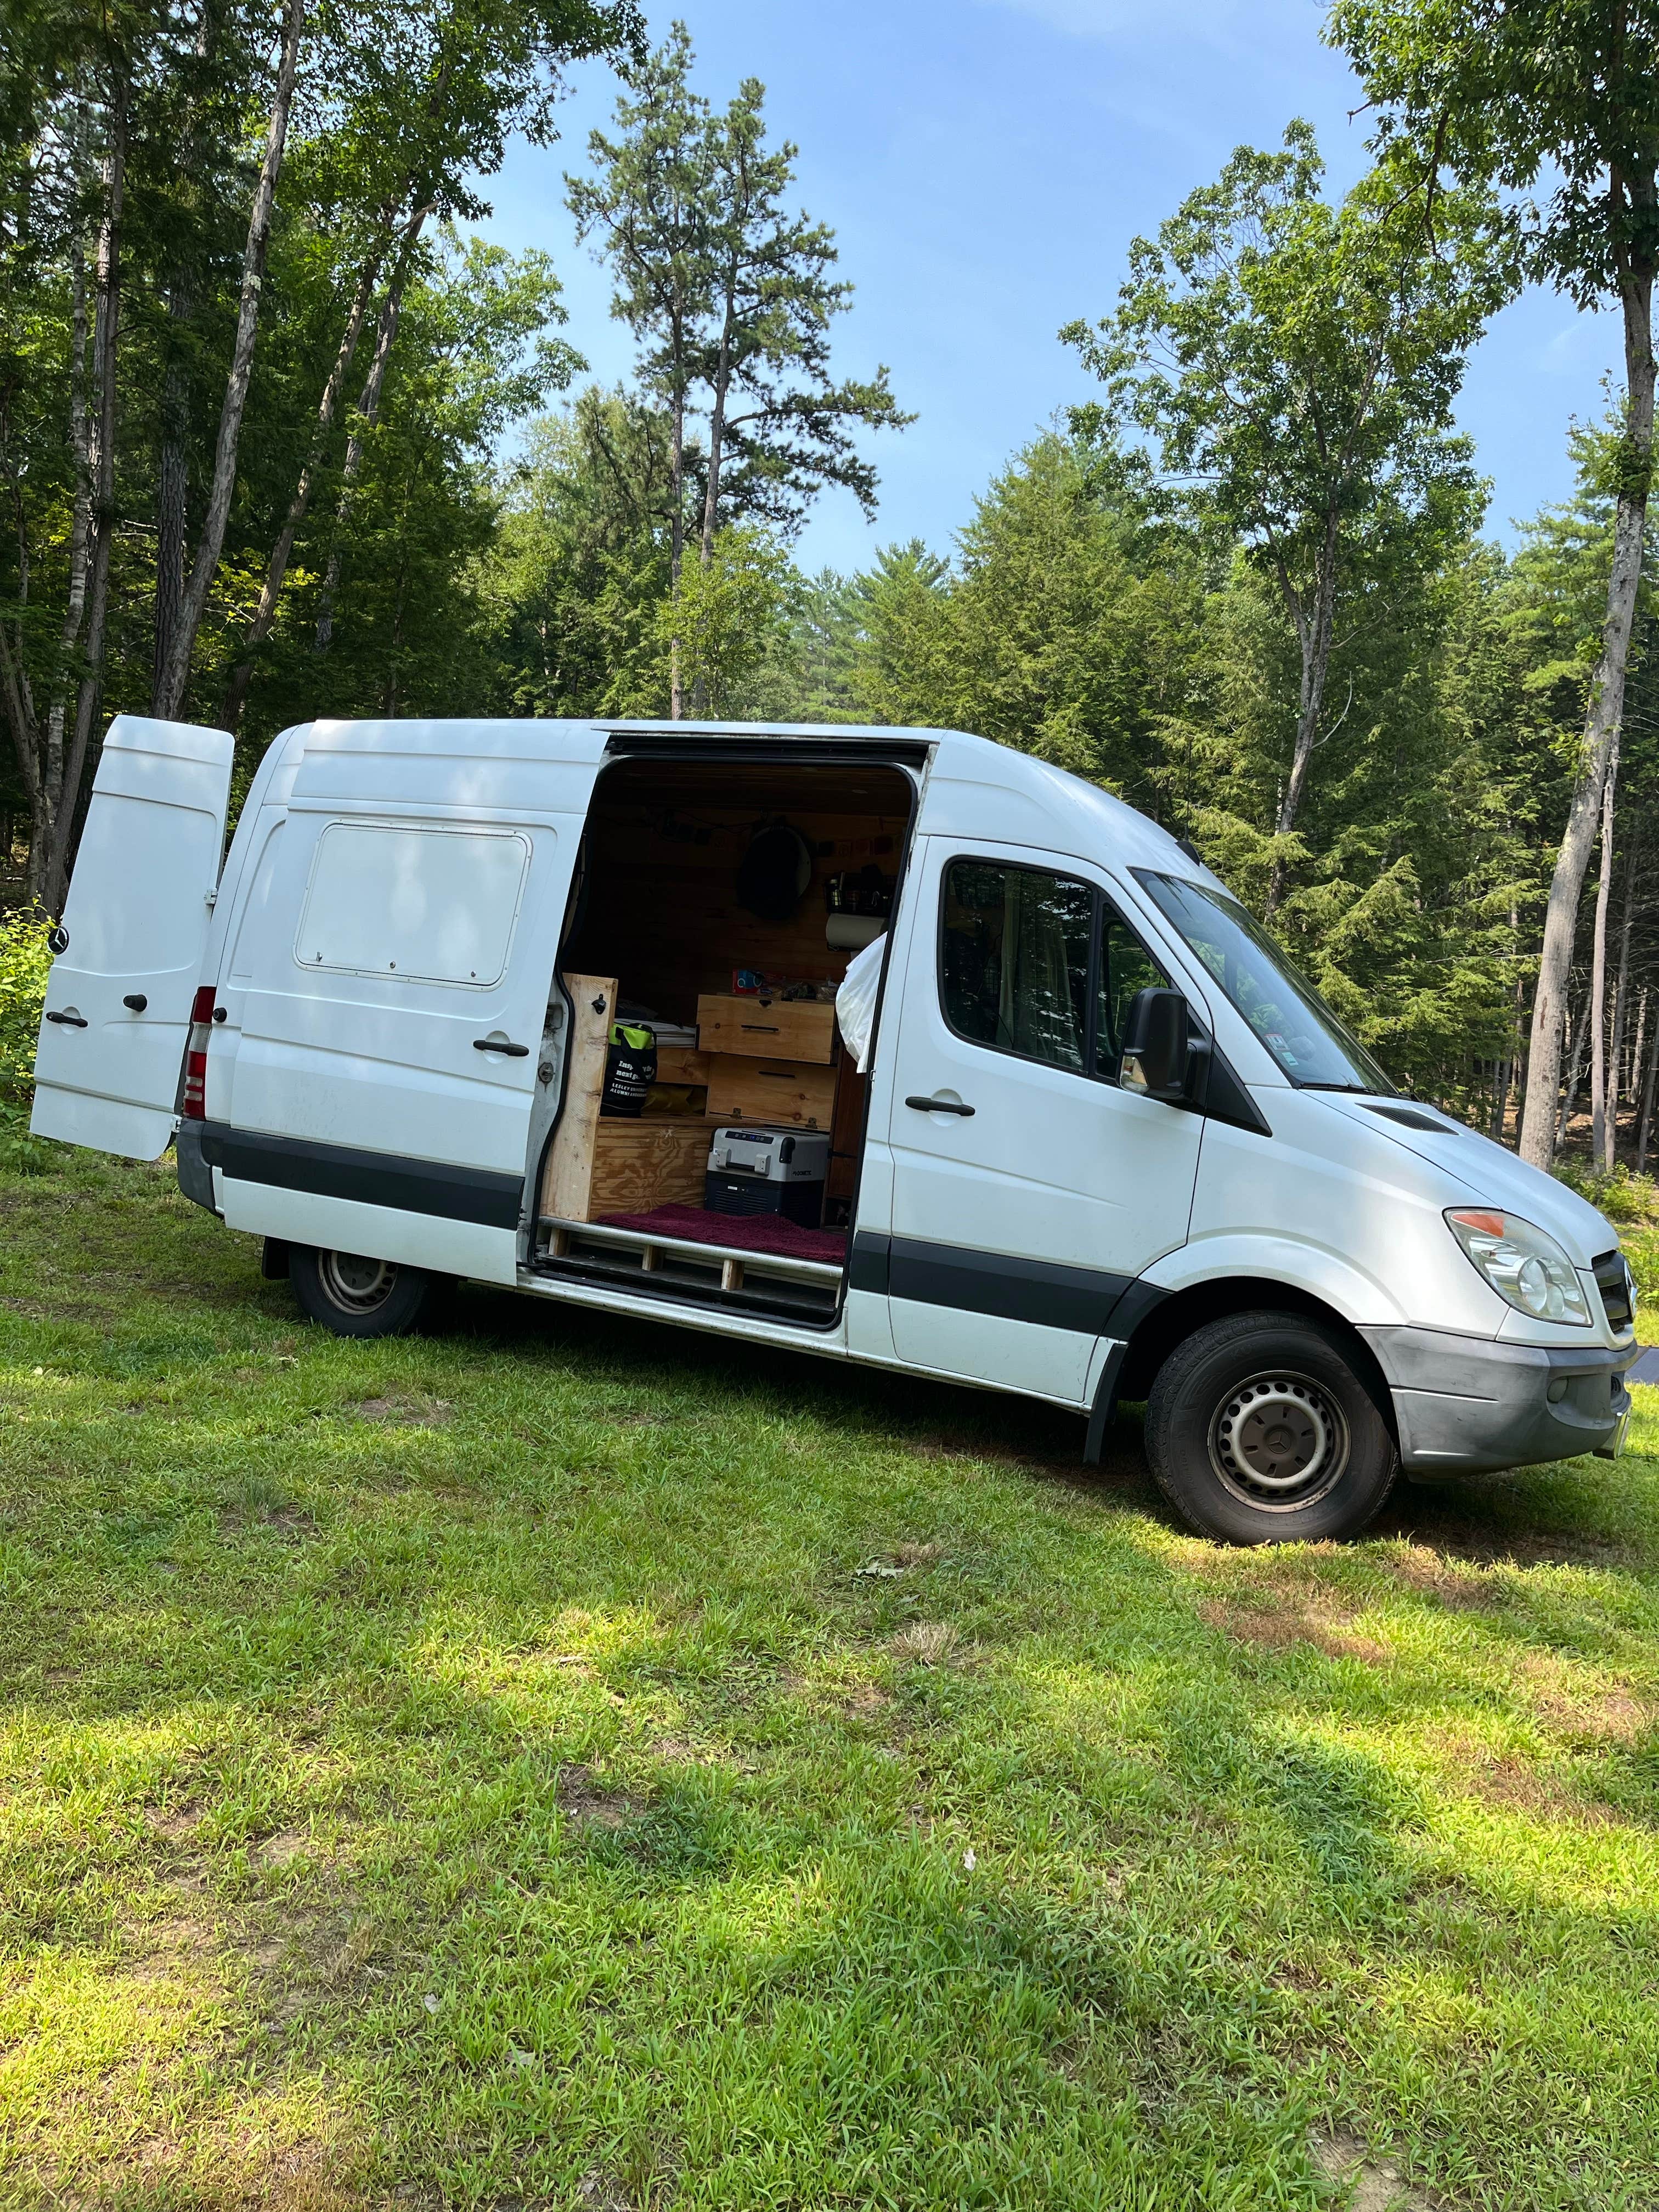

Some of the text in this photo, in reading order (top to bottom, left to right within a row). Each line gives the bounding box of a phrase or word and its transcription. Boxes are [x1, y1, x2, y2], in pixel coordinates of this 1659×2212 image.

[616, 1070, 633, 1078] next
[612, 1082, 630, 1091] LESLEY
[610, 1088, 630, 1096] ALUMNI
